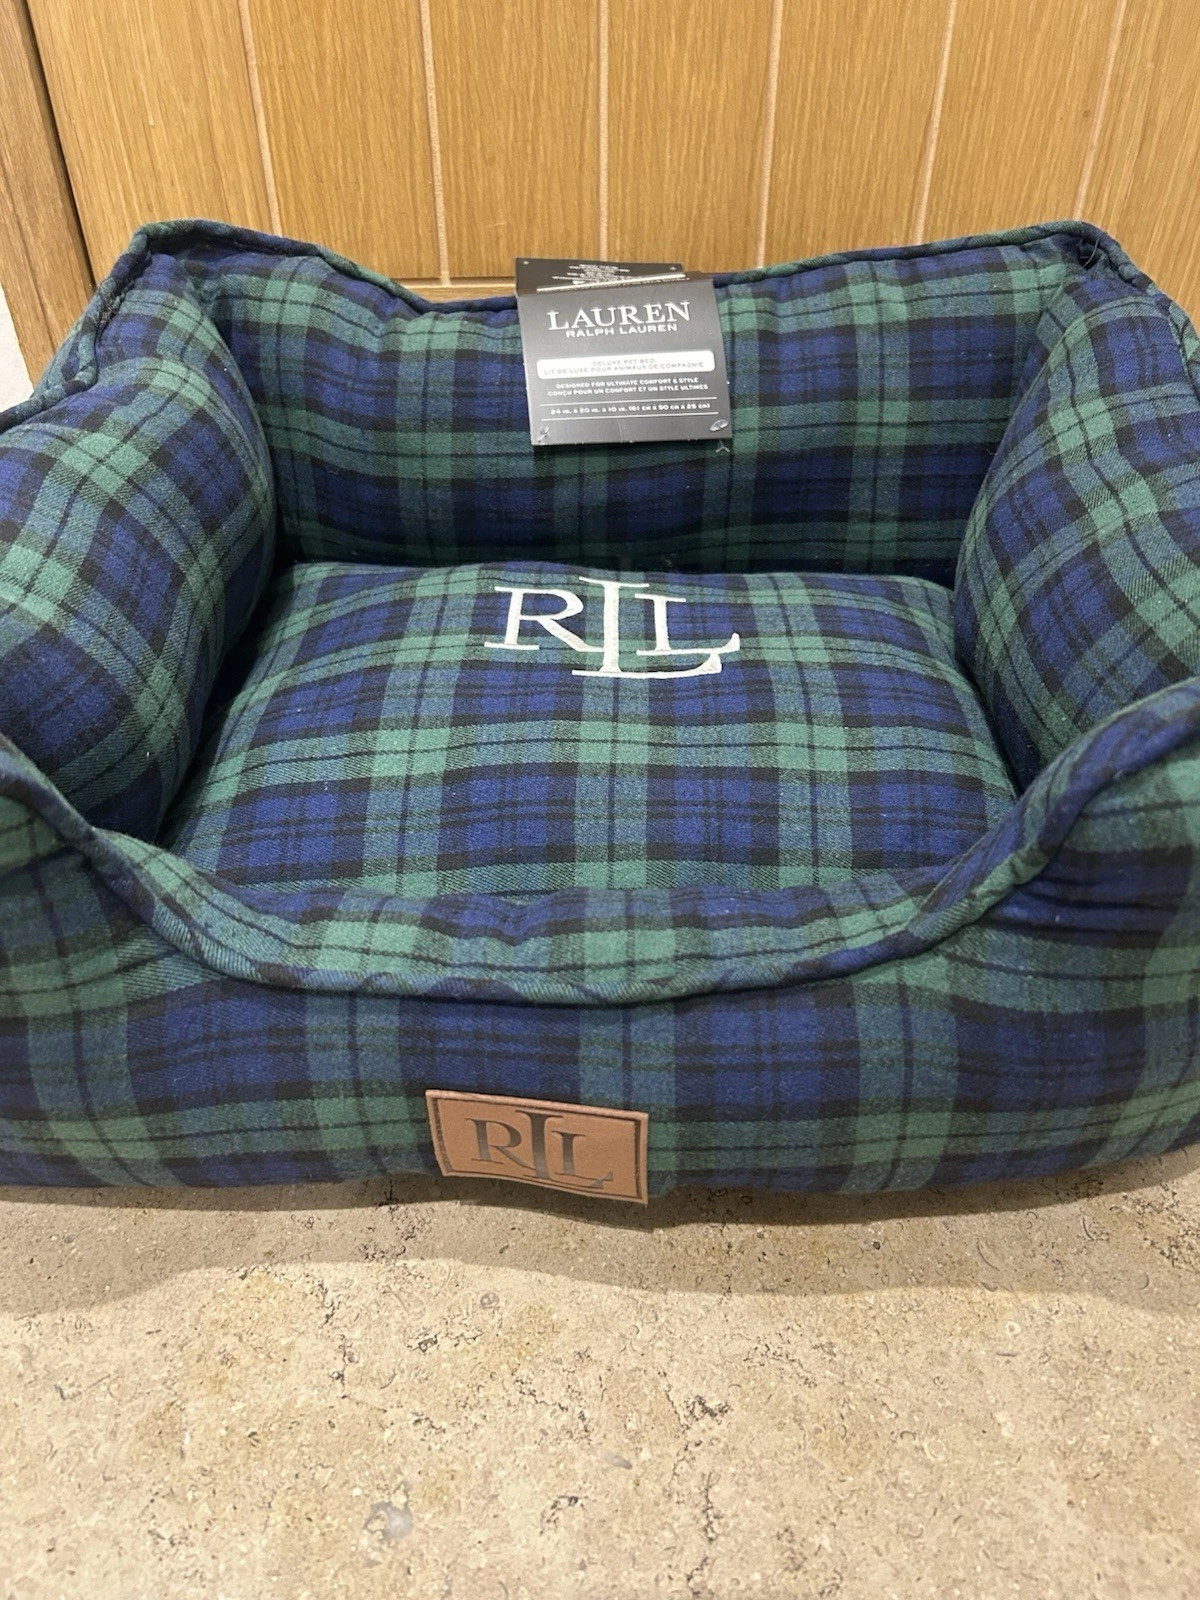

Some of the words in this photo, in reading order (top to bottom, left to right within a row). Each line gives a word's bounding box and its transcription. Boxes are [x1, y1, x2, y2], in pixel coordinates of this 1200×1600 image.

[547, 302, 690, 330] LAUREN
[566, 328, 614, 338] RALPH
[620, 324, 678, 335] LAUREN
[660, 362, 704, 370] COMPAGNIE
